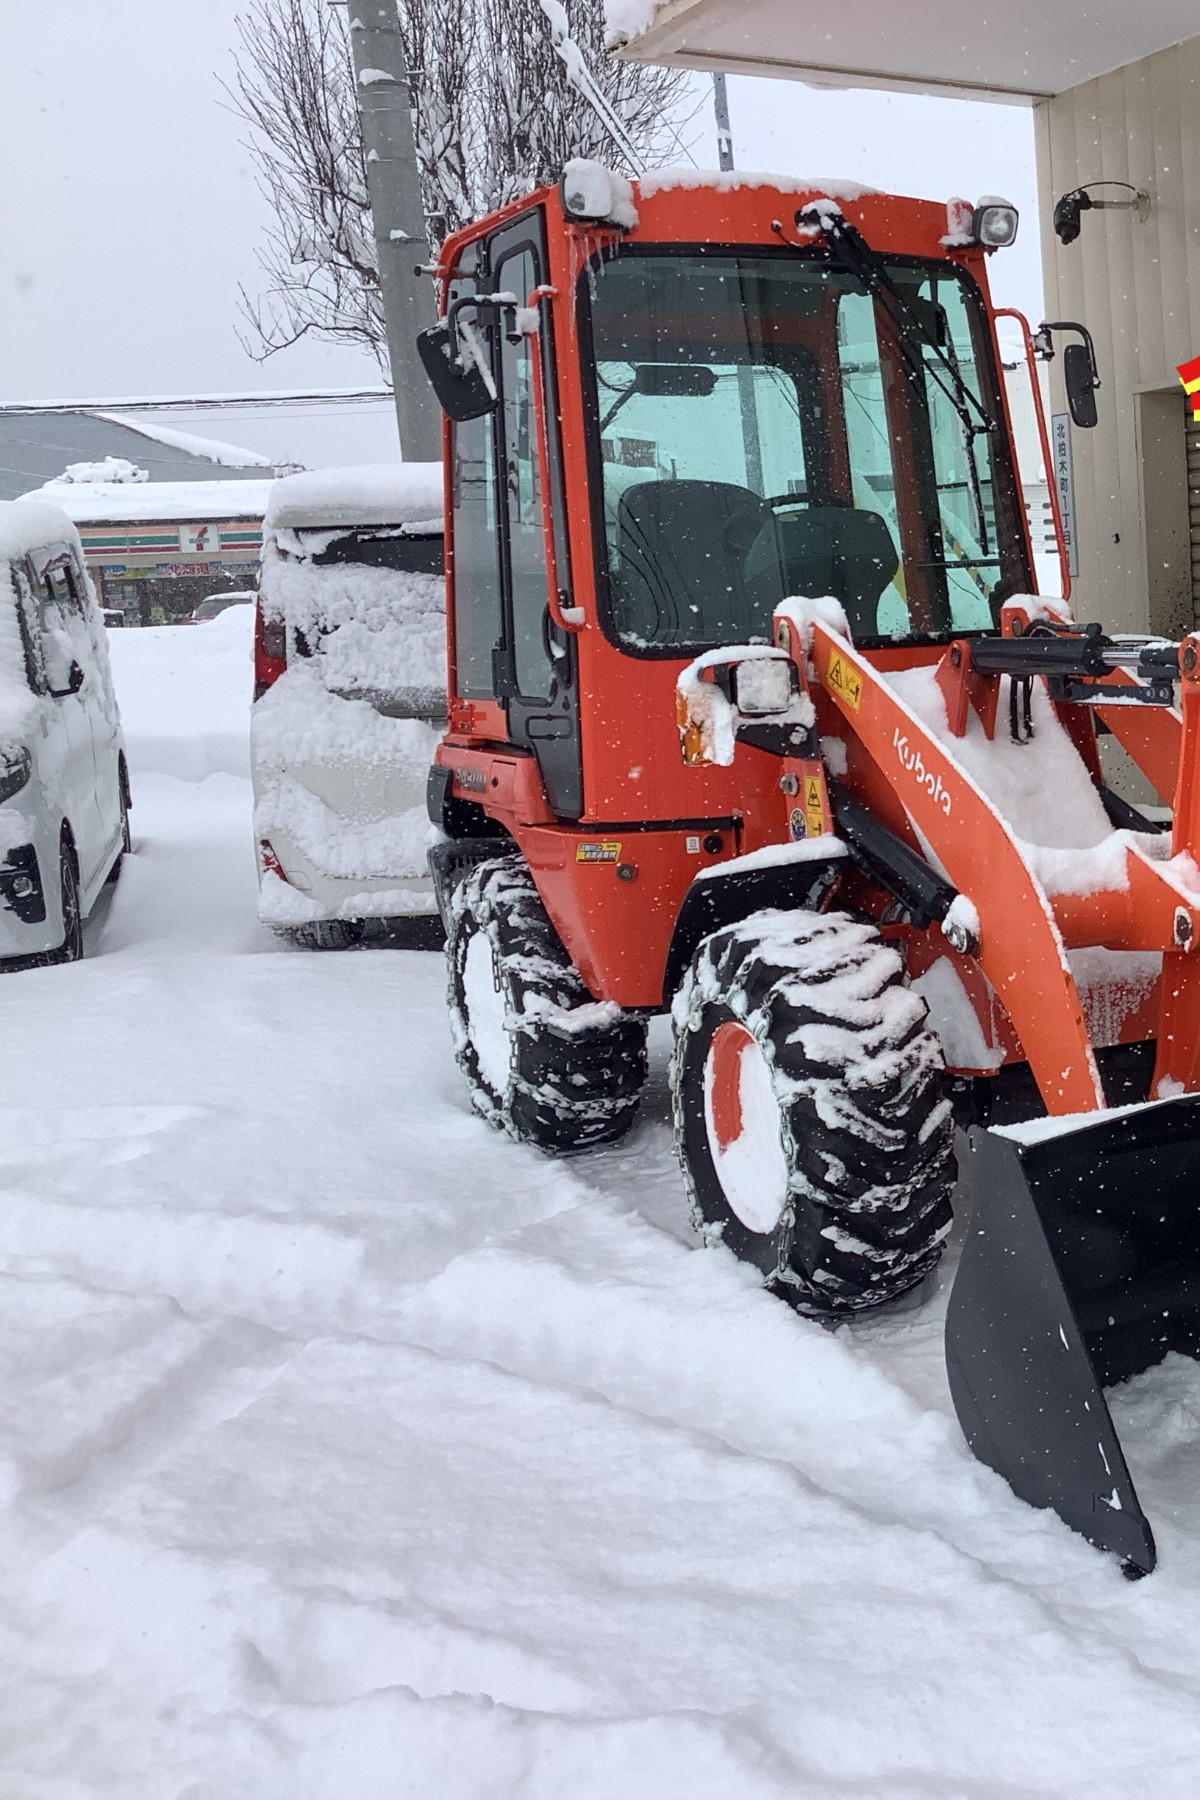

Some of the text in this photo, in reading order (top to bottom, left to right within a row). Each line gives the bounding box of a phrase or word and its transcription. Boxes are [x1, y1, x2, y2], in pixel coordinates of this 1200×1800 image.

[167, 562, 210, 576] 北海道
[892, 726, 952, 817] Kubota
